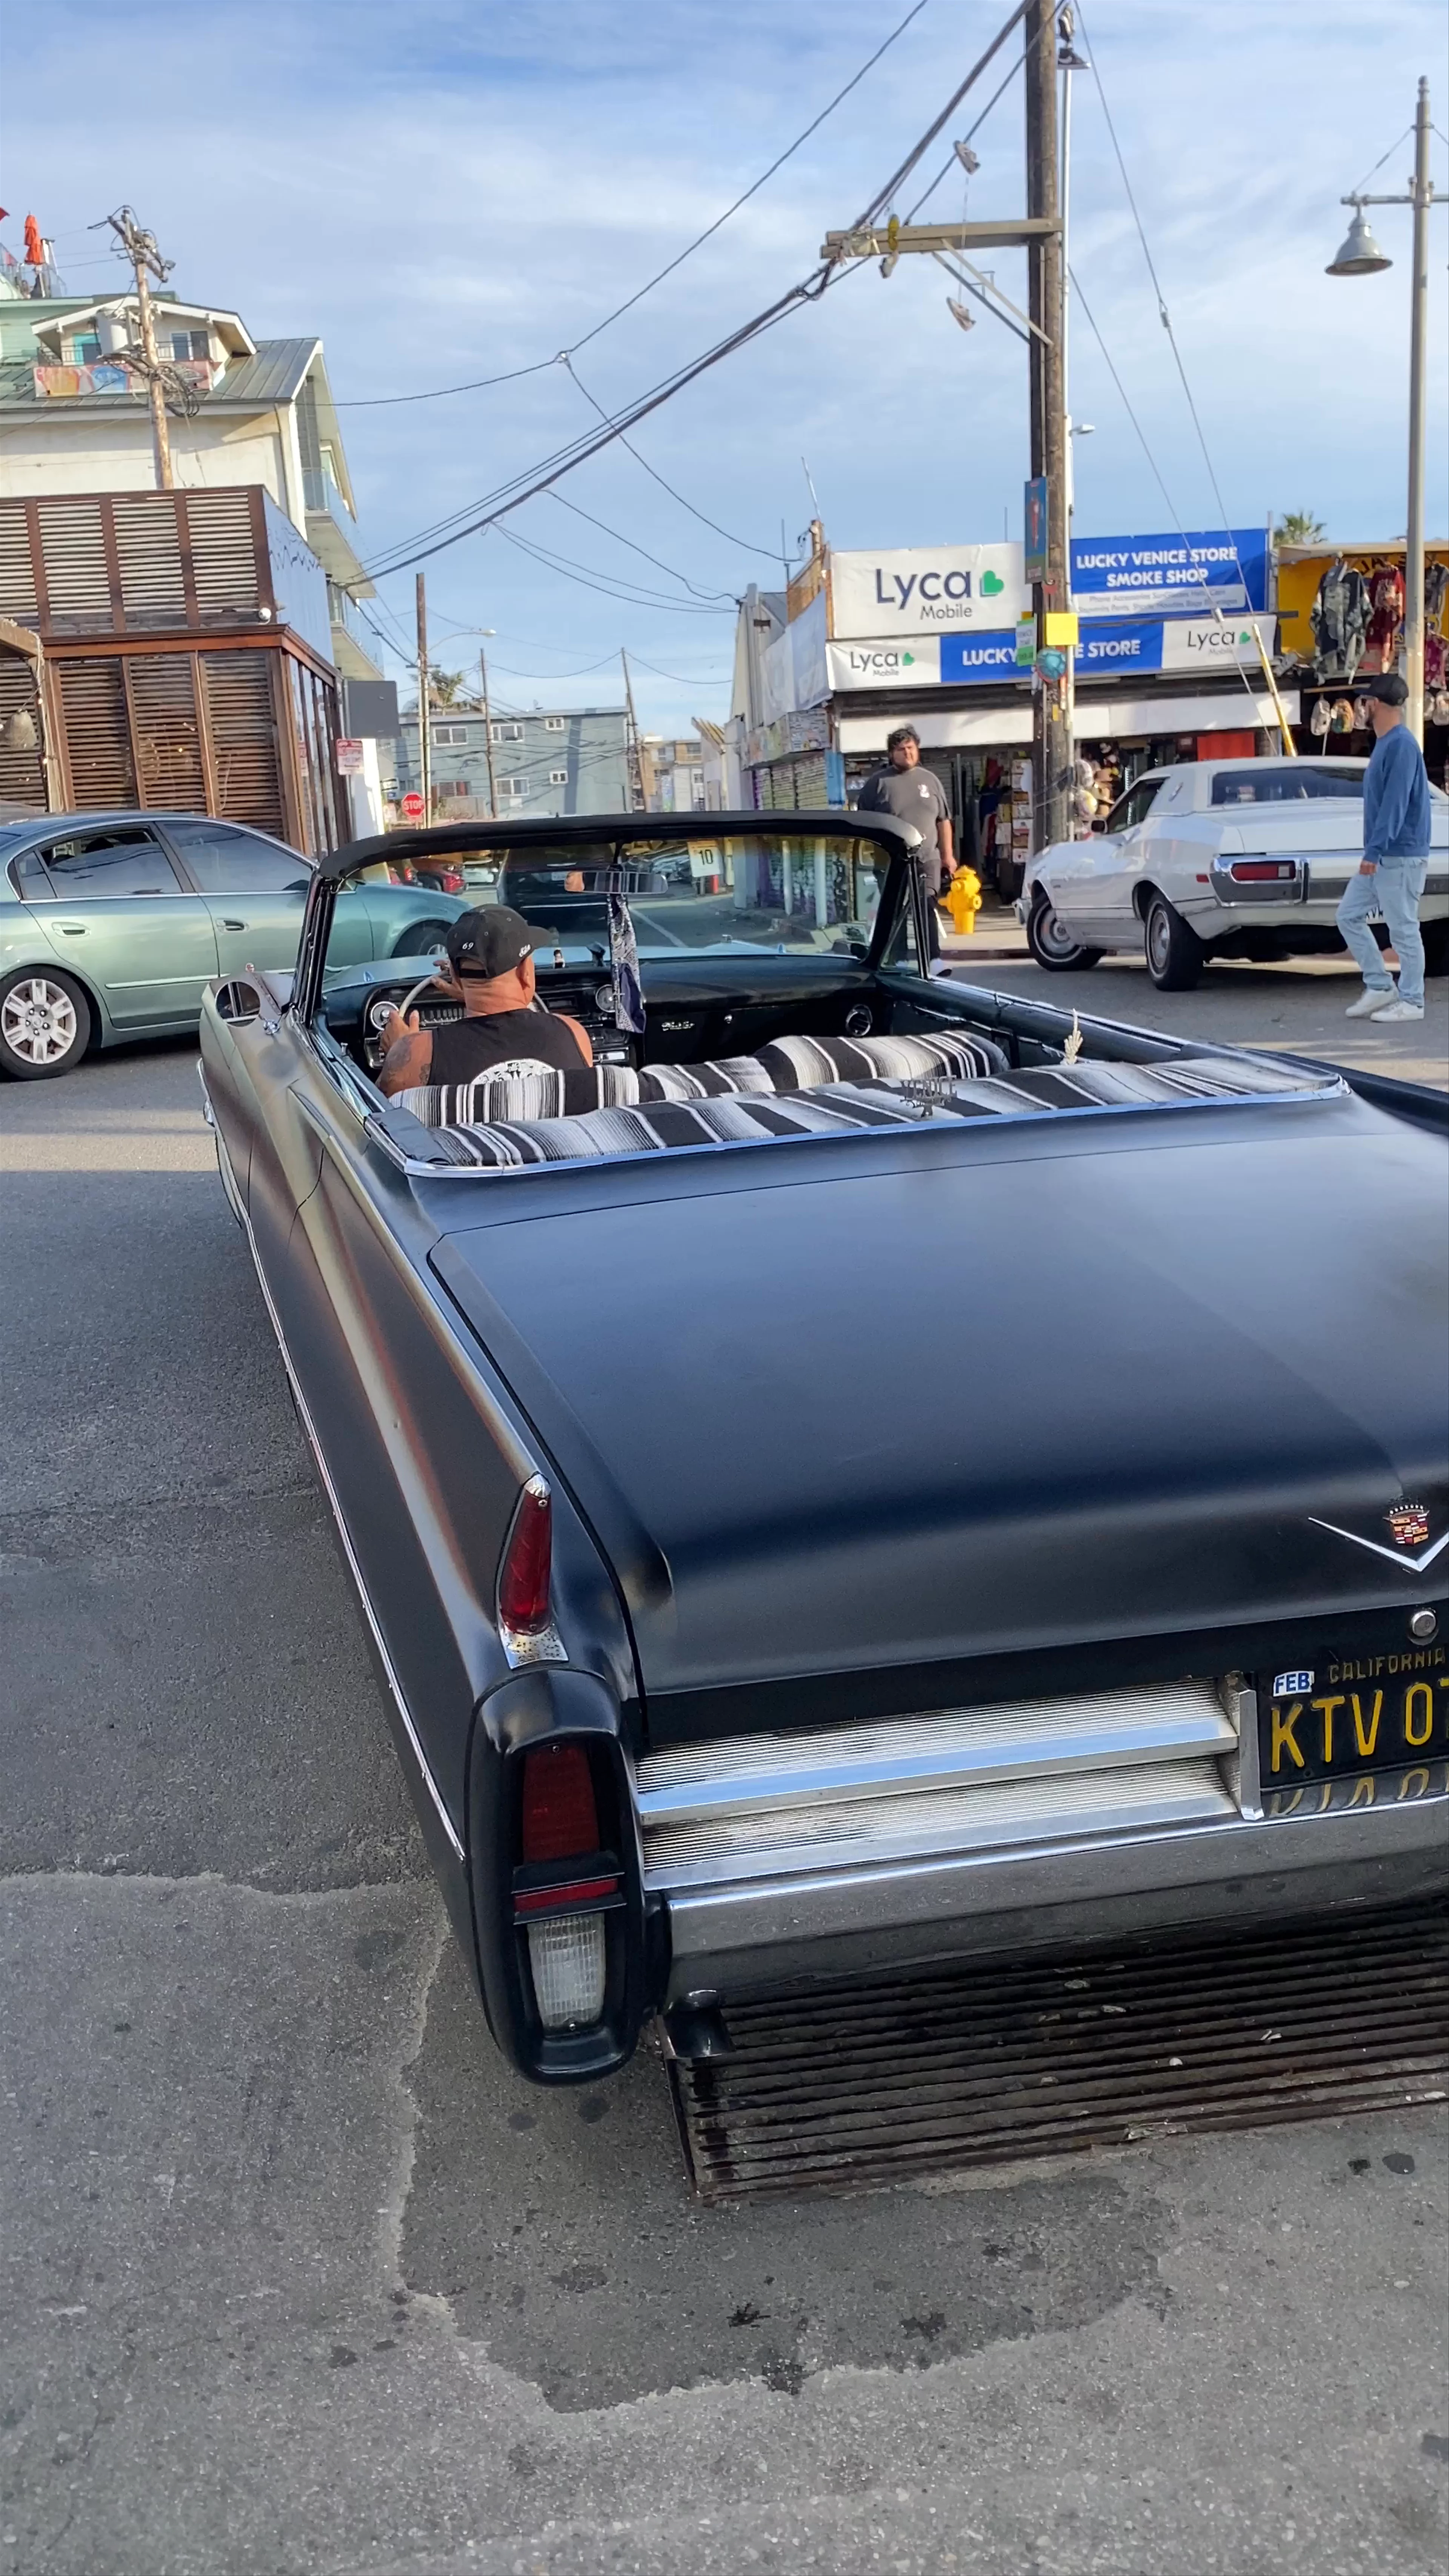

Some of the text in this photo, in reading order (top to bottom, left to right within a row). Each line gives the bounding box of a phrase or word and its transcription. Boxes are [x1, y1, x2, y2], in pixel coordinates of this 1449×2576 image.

[1076, 546, 1237, 569] LUCKY VENICE STORE
[1106, 568, 1209, 587] SMOKE SHOP
[875, 568, 971, 610] Lyca
[920, 604, 973, 620] Mobile
[1188, 631, 1235, 651] Lyca
[851, 652, 899, 672] Lyca
[962, 647, 1017, 666] LUCKY
[1088, 639, 1141, 658] STORE
[403, 800, 424, 810] STOP
[1329, 1647, 1446, 1684] CALIFORNIA
[1275, 1673, 1310, 1694] FEB
[1271, 1689, 1383, 1772] KTV
